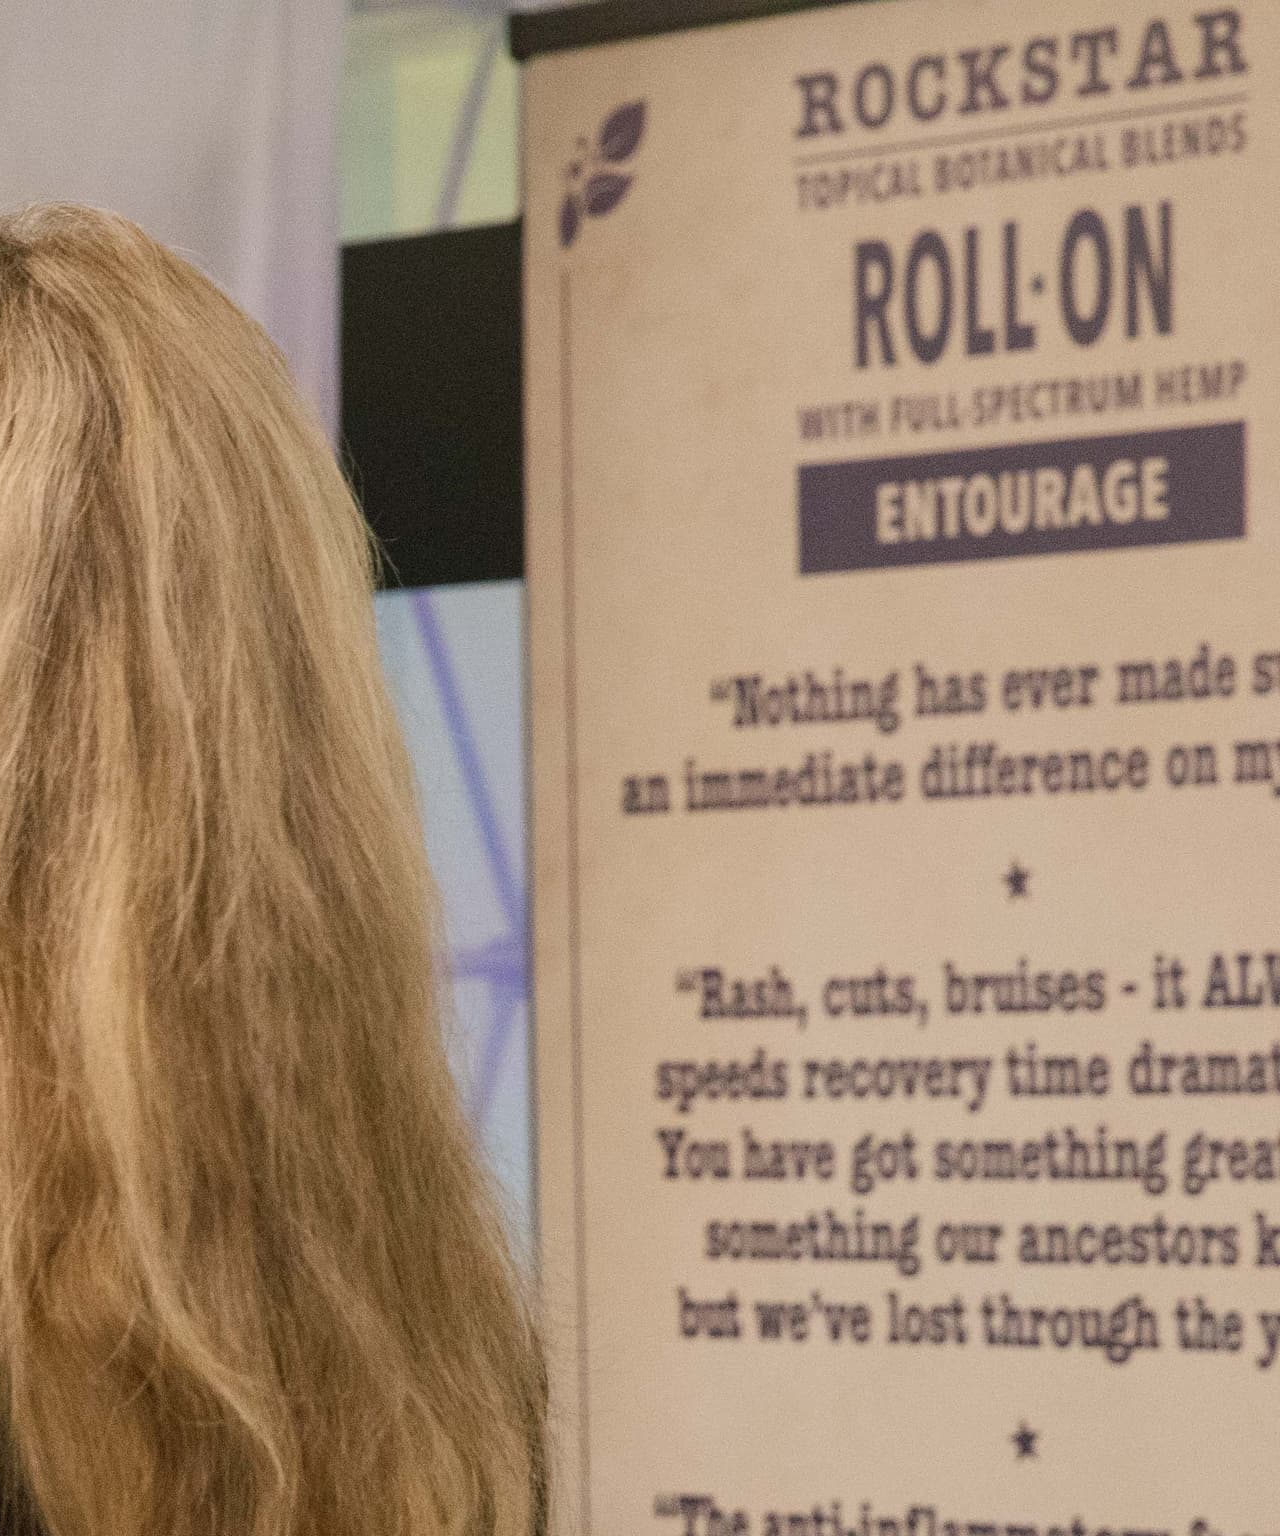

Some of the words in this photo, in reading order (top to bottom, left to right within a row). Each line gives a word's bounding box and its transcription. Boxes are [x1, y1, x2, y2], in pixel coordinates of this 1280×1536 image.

[794, 8, 1249, 140] ROCKSTAR
[796, 160, 922, 210] TOPICAL
[935, 132, 1110, 194] BOTANICAL
[1121, 112, 1247, 168] BLENDS
[797, 398, 881, 442] WITH
[1155, 360, 1247, 407] HEMP
[875, 455, 1169, 546] ENTOURAGE
[915, 662, 988, 717] has
[1002, 661, 1099, 711] ever
[1116, 642, 1237, 704] made
[1252, 652, 1280, 694] s
[623, 773, 671, 816] an
[686, 749, 905, 812] immediate
[921, 741, 1149, 800] difference
[1167, 743, 1218, 787] on
[1233, 738, 1280, 798] m
[823, 963, 931, 1028] cuts,
[945, 960, 1107, 1015] bruises
[1154, 956, 1188, 1011] it
[655, 1047, 791, 1115] speeds
[805, 1055, 992, 1113] recovery
[1007, 1041, 1110, 1096] time
[656, 1128, 731, 1180] You
[744, 1127, 834, 1181] have
[852, 1132, 920, 1195] got
[935, 1123, 1168, 1195] something
[705, 1207, 920, 1278] something
[935, 1223, 1004, 1265] our
[1020, 1216, 1240, 1267] ancestors
[678, 1287, 742, 1339] but
[886, 1291, 967, 1345] lost
[981, 1292, 1160, 1364] through
[1176, 1296, 1242, 1352] the
